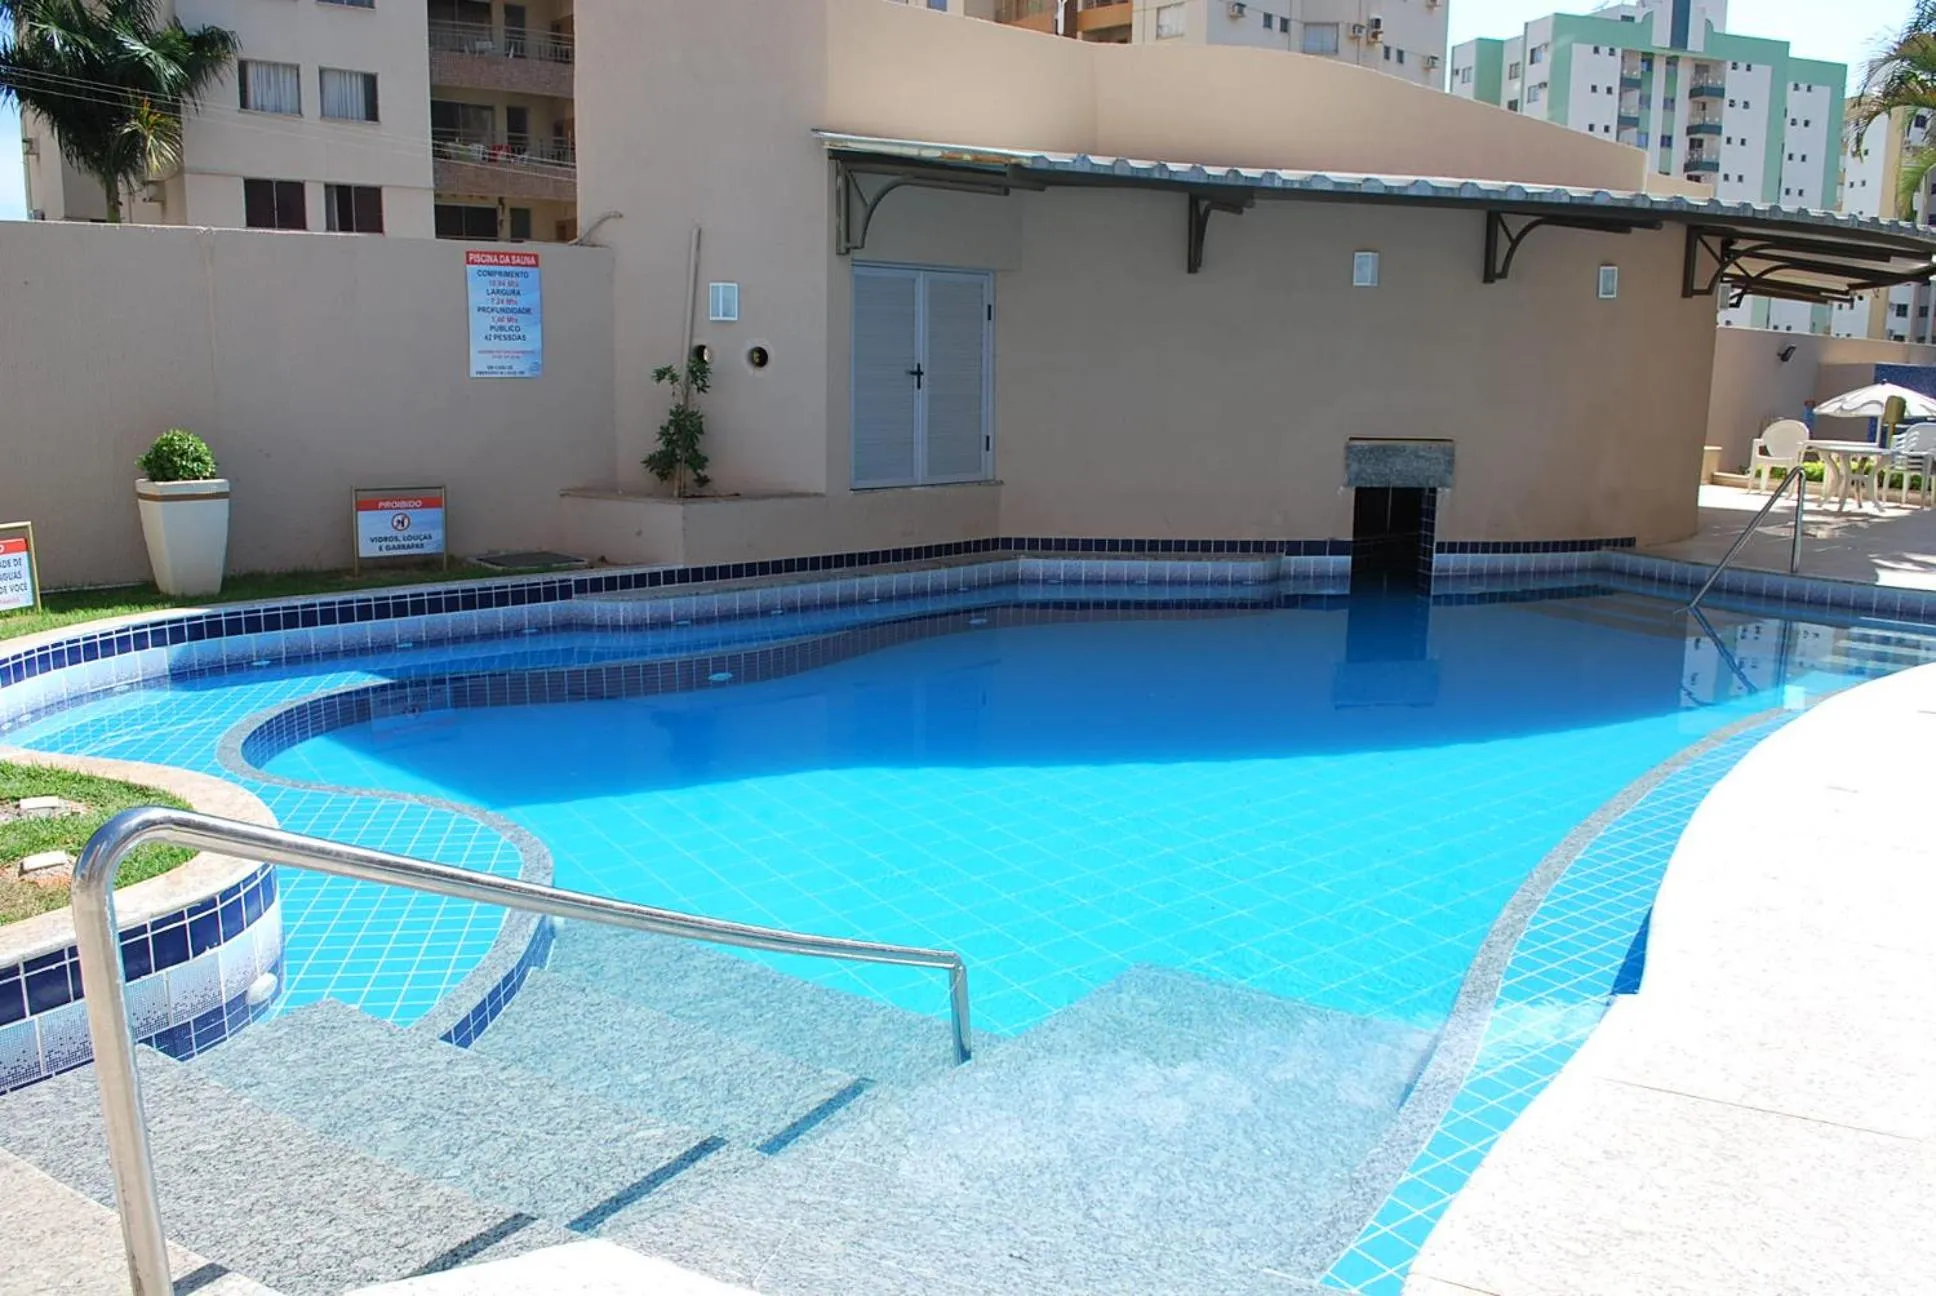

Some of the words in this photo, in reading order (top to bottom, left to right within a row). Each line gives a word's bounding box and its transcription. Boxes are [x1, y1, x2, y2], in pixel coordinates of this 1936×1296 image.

[468, 252, 498, 263] PISCINA
[500, 254, 510, 263] DA
[511, 255, 536, 265] SAUNA
[477, 270, 529, 278] COMPRIMENTO
[486, 288, 521, 296] LARGURA
[477, 306, 532, 314] PROFUNDIDADE
[493, 333, 527, 341] PESSOAS
[378, 499, 422, 509] PROIBIDO
[13, 558, 22, 567] DE
